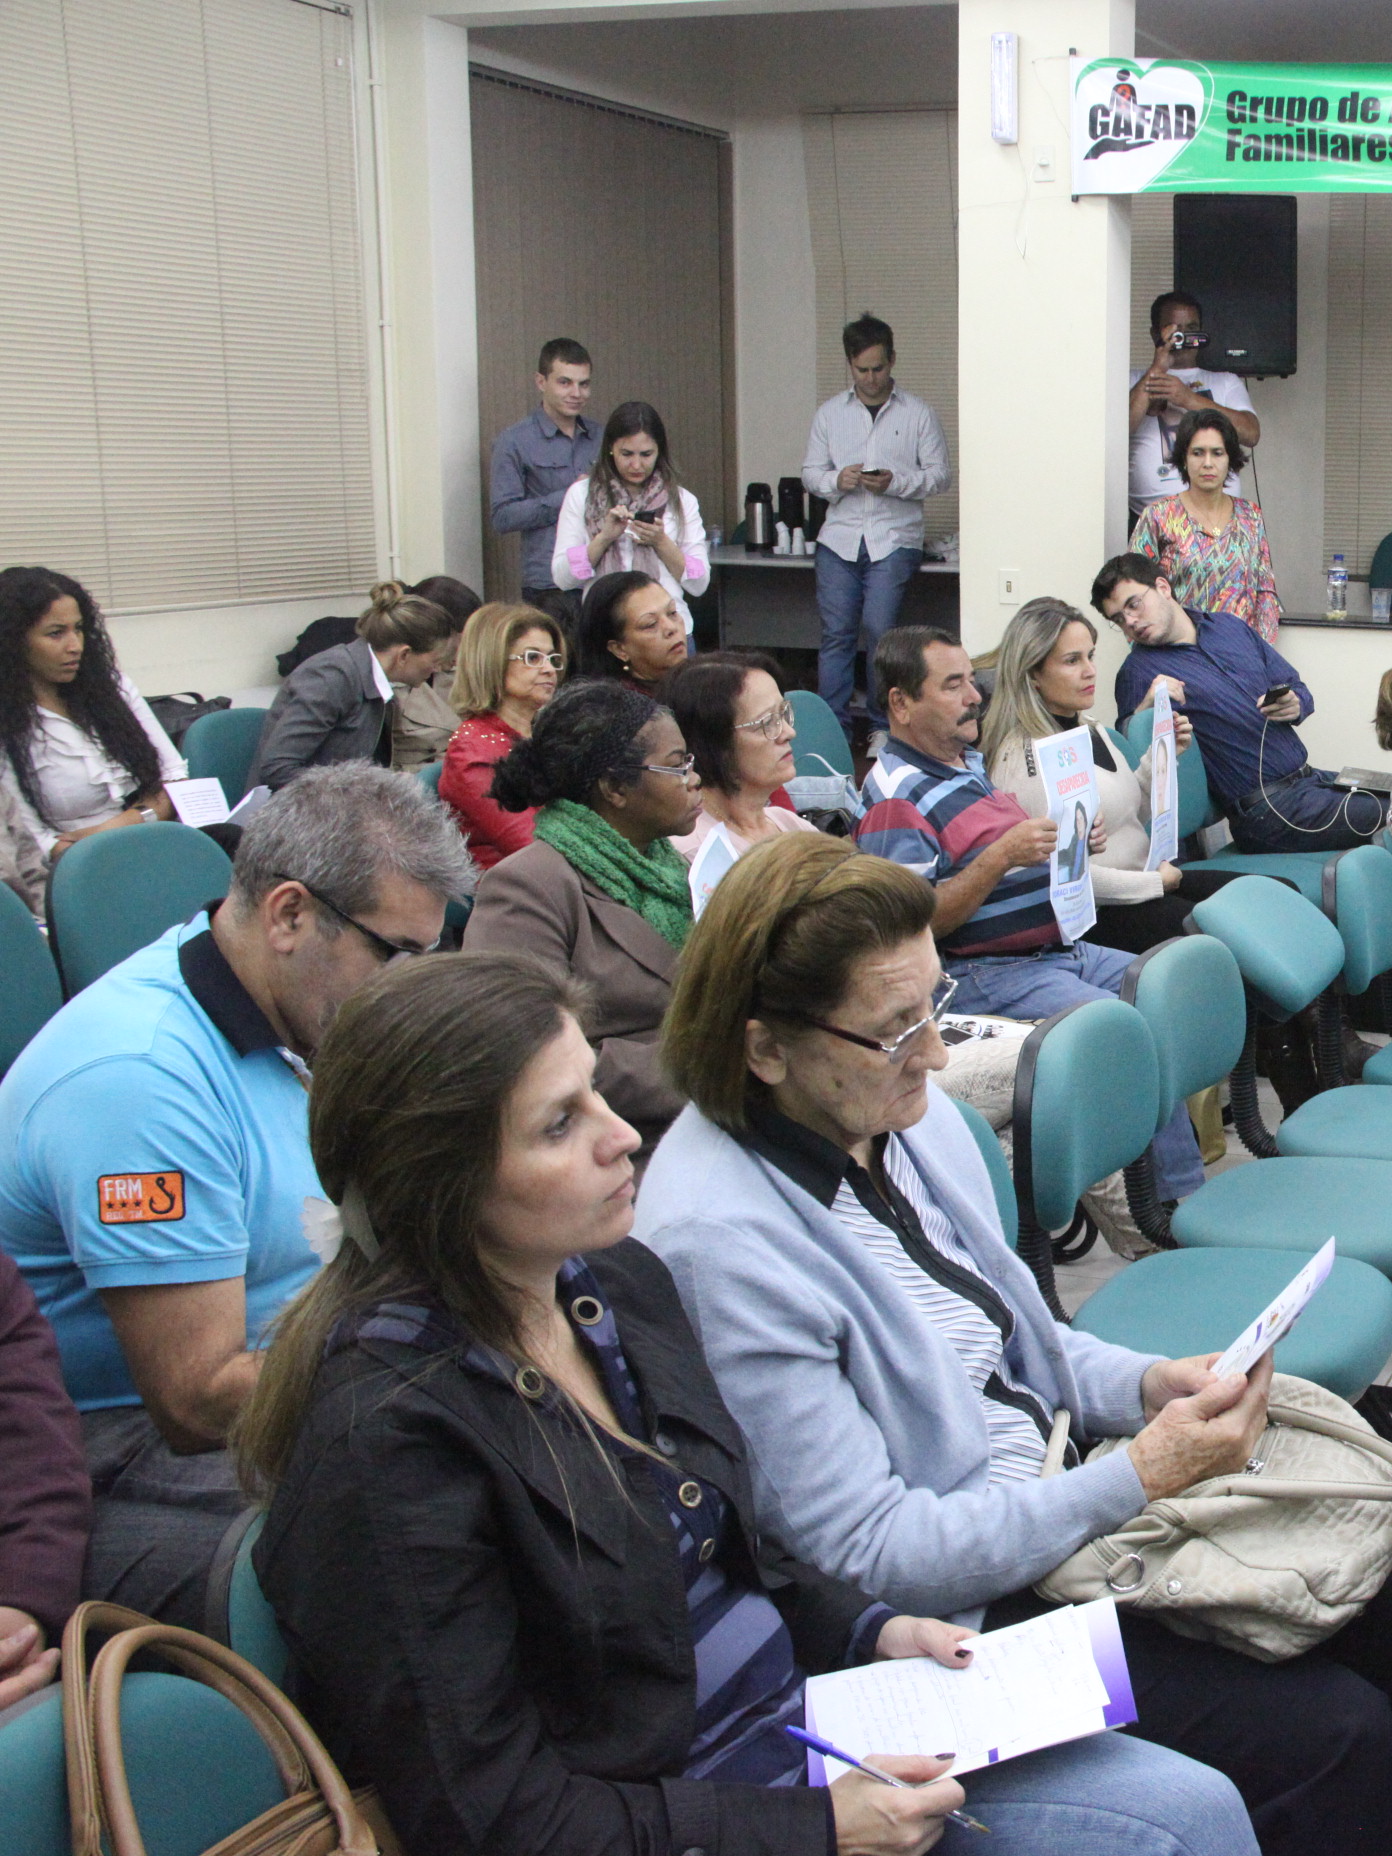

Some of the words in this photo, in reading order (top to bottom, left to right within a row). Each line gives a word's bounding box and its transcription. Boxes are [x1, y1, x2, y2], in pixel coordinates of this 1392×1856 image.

[1088, 103, 1196, 141] GAFAD
[1225, 90, 1329, 127] Grupo
[1337, 91, 1382, 124] de
[103, 1178, 143, 1201] FRM
